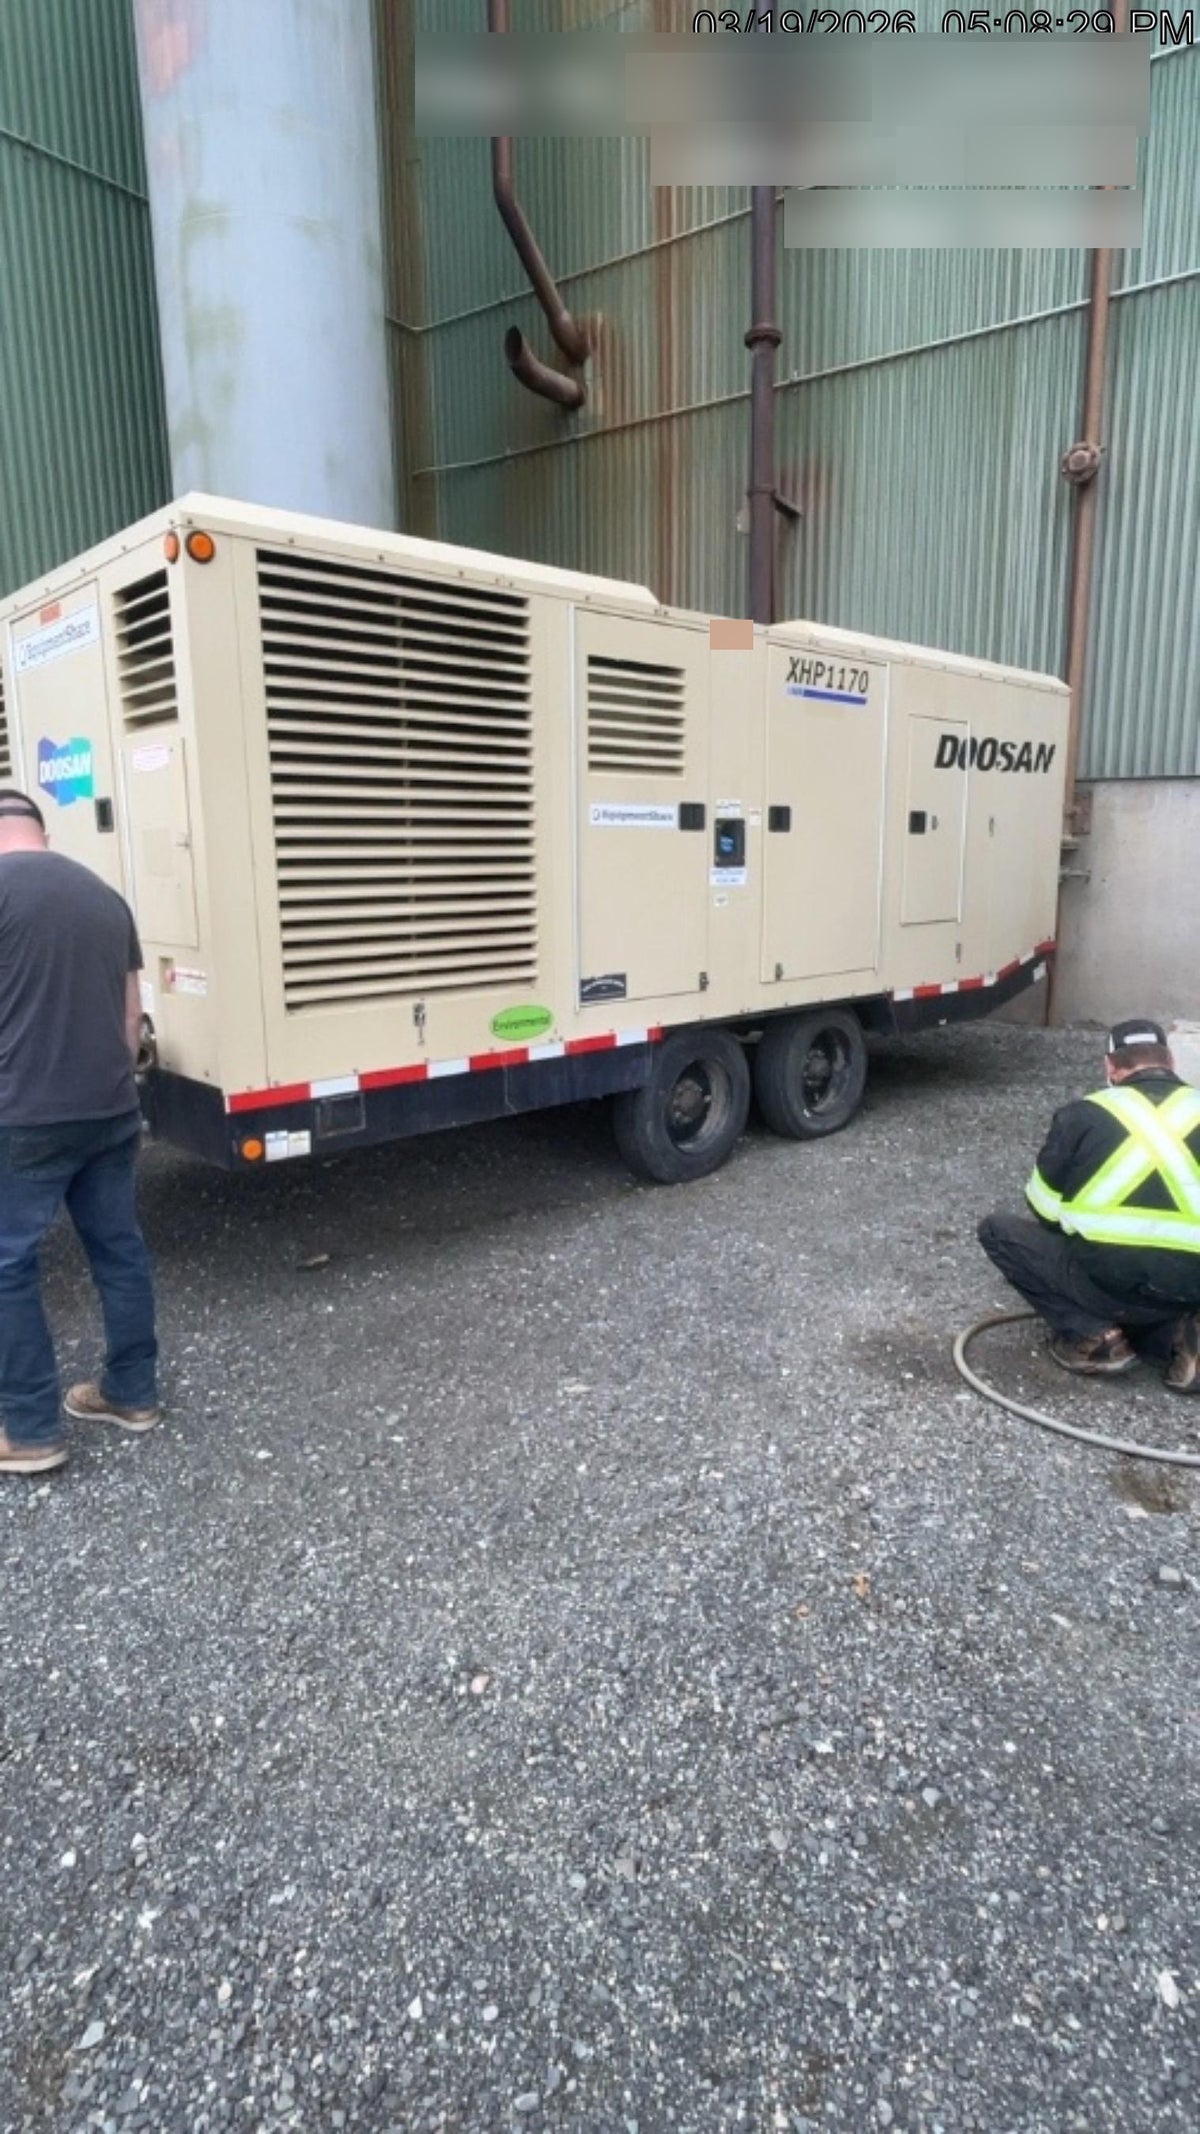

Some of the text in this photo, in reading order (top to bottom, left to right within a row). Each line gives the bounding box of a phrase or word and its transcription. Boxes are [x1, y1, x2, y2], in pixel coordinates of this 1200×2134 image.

[786, 656, 869, 694] XHP1170
[39, 752, 91, 784] DOOSAN
[934, 733, 1056, 774] DOOSAN
[493, 1014, 551, 1032] Environmental
